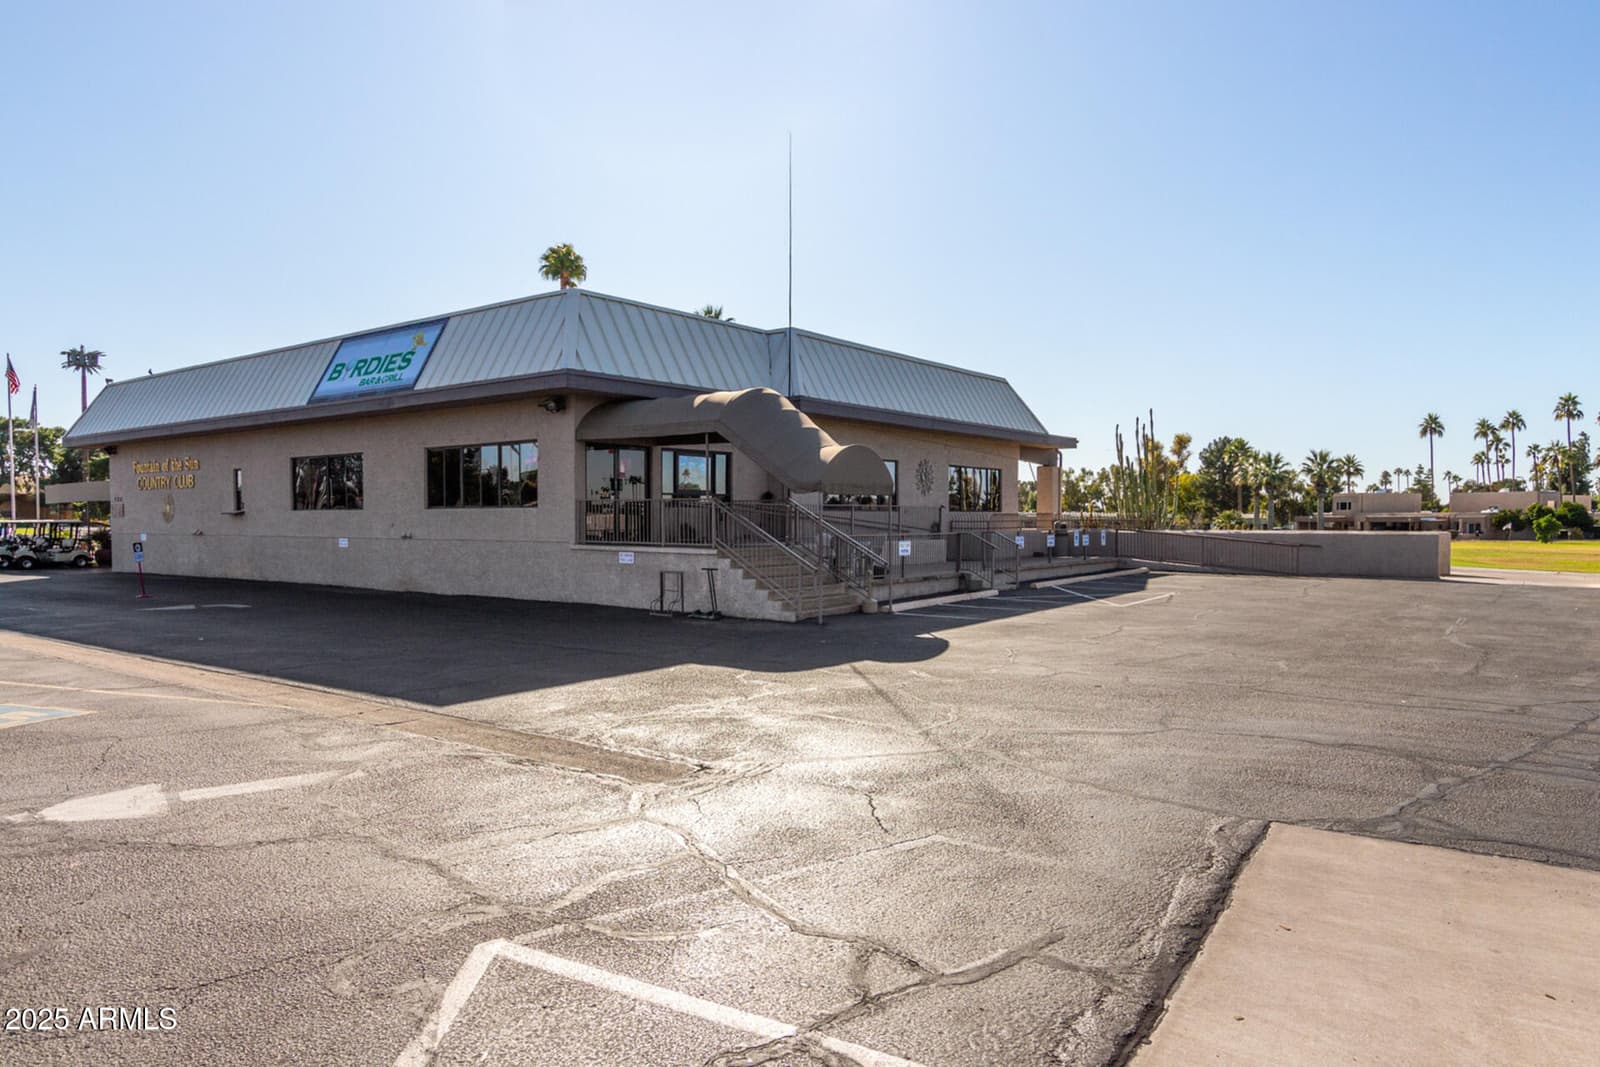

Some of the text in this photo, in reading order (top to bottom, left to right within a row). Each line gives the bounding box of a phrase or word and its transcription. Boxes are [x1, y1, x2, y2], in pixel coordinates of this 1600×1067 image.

[162, 458, 170, 472] of
[137, 474, 195, 490] COUNTRY CLUB
